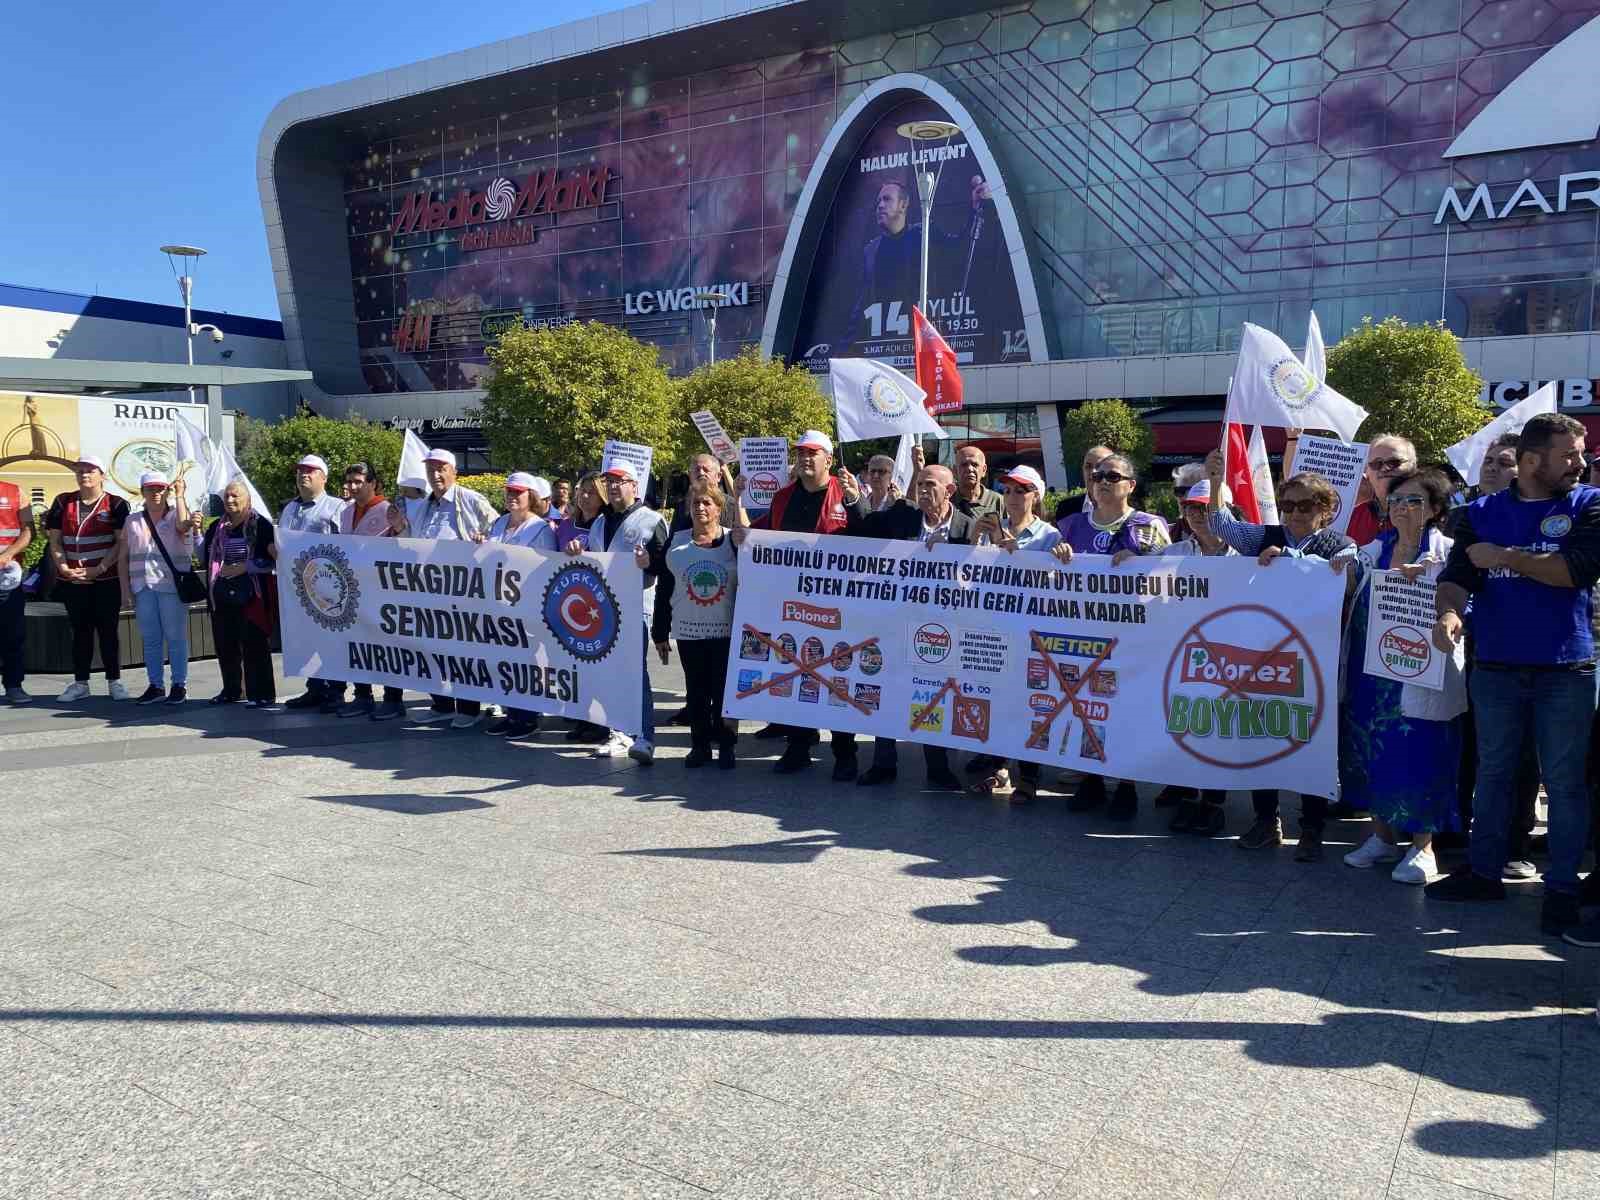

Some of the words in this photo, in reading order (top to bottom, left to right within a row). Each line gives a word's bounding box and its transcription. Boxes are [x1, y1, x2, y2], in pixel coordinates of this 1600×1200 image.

[861, 152, 908, 172] HALUK
[911, 143, 968, 165] LEVENT
[1432, 170, 1600, 225] MAR
[625, 291, 654, 315] LC
[863, 300, 910, 337] 14
[918, 291, 976, 318] YLÜL
[947, 317, 979, 331] 19.30
[114, 403, 179, 421] RADO
[374, 560, 485, 600] TEKGIDA
[495, 561, 521, 607] İŞ
[752, 544, 823, 570] ÜRDÜNLÜ
[826, 553, 895, 577] POLONEZ
[899, 558, 958, 581] ŞİRKETİ
[961, 563, 1050, 591] SENDİKAYA
[1053, 570, 1083, 594] ÜYE
[1087, 572, 1161, 599] OLDUĞU
[1167, 573, 1210, 601] İÇİN
[785, 603, 838, 625] Polonez
[797, 572, 843, 597] İŞTEN
[845, 578, 898, 602] ATTIĞI
[900, 584, 930, 605] 146
[934, 584, 980, 612] İŞÇİYİ
[983, 588, 1024, 614] GERİ
[1026, 597, 1081, 619] ALANA
[1083, 603, 1147, 625] KADAR
[379, 603, 530, 649] SENDİKASI
[567, 636, 602, 652] 1952
[1041, 636, 1108, 657] METRO
[348, 641, 433, 680] AVRUPA
[432, 652, 495, 689] YAKA
[498, 660, 580, 704] ŞUBESİ
[1187, 647, 1294, 685] Polonez
[1166, 694, 1315, 744] BOYKOT
